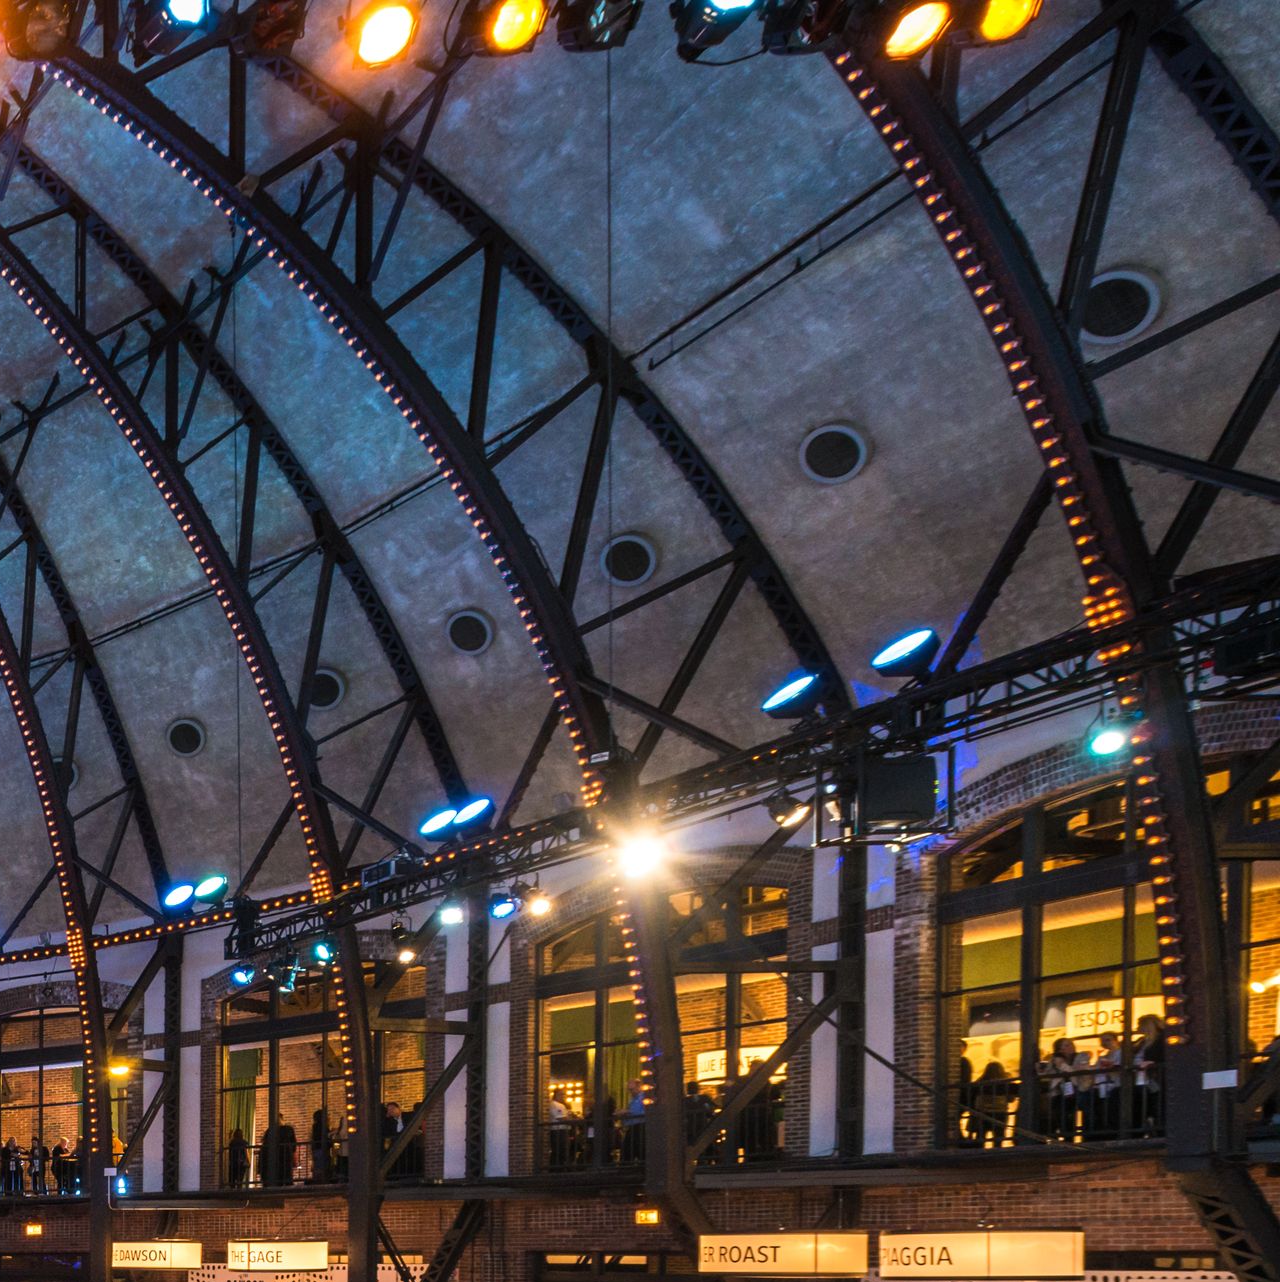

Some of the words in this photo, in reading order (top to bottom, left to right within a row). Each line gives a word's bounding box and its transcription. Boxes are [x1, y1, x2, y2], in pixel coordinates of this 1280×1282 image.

[120, 1250, 166, 1261] DAWSON
[231, 1251, 244, 1262] THE
[249, 1250, 282, 1263] GAGE
[719, 1246, 781, 1263] ROAST
